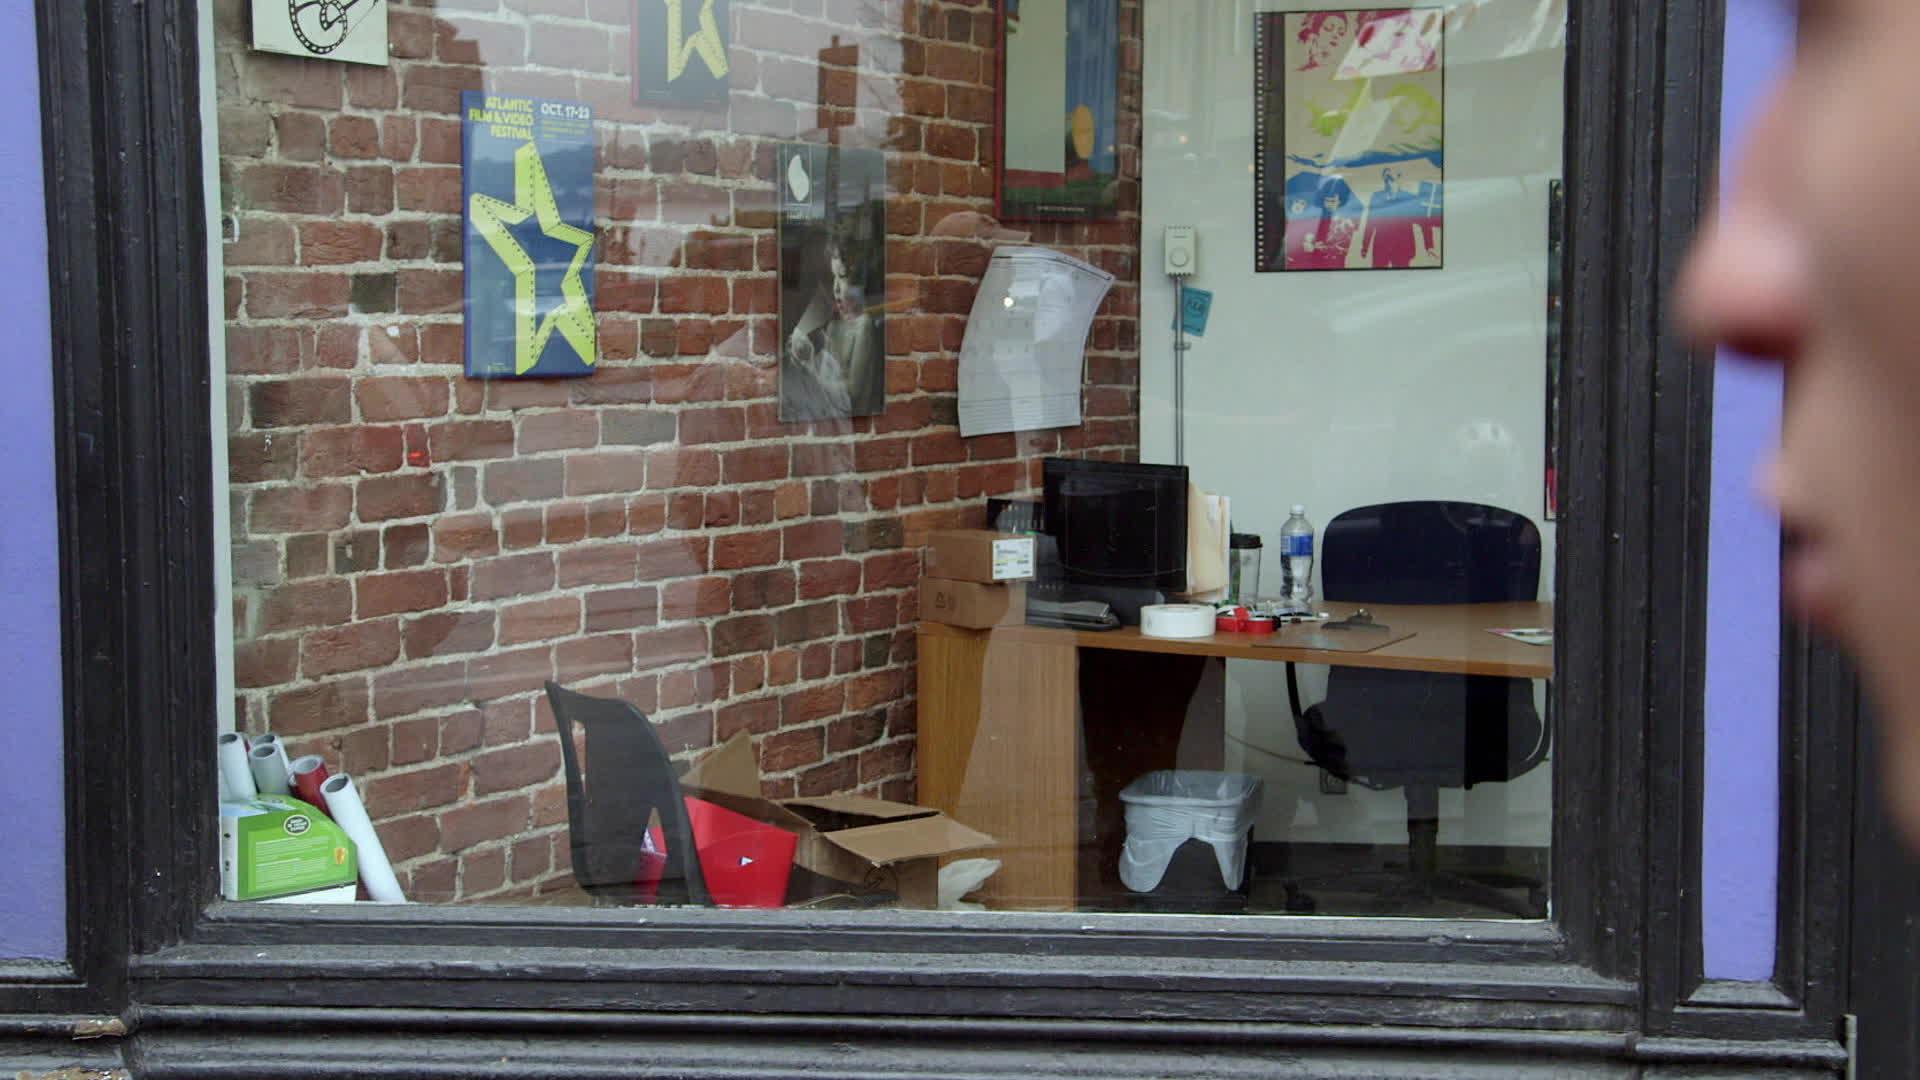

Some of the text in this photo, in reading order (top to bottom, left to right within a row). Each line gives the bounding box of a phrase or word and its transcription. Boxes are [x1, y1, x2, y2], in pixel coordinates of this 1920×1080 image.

[485, 97, 533, 112] ATLANTIC
[541, 103, 564, 116] OCT.
[490, 125, 533, 140] FESTIVAL
